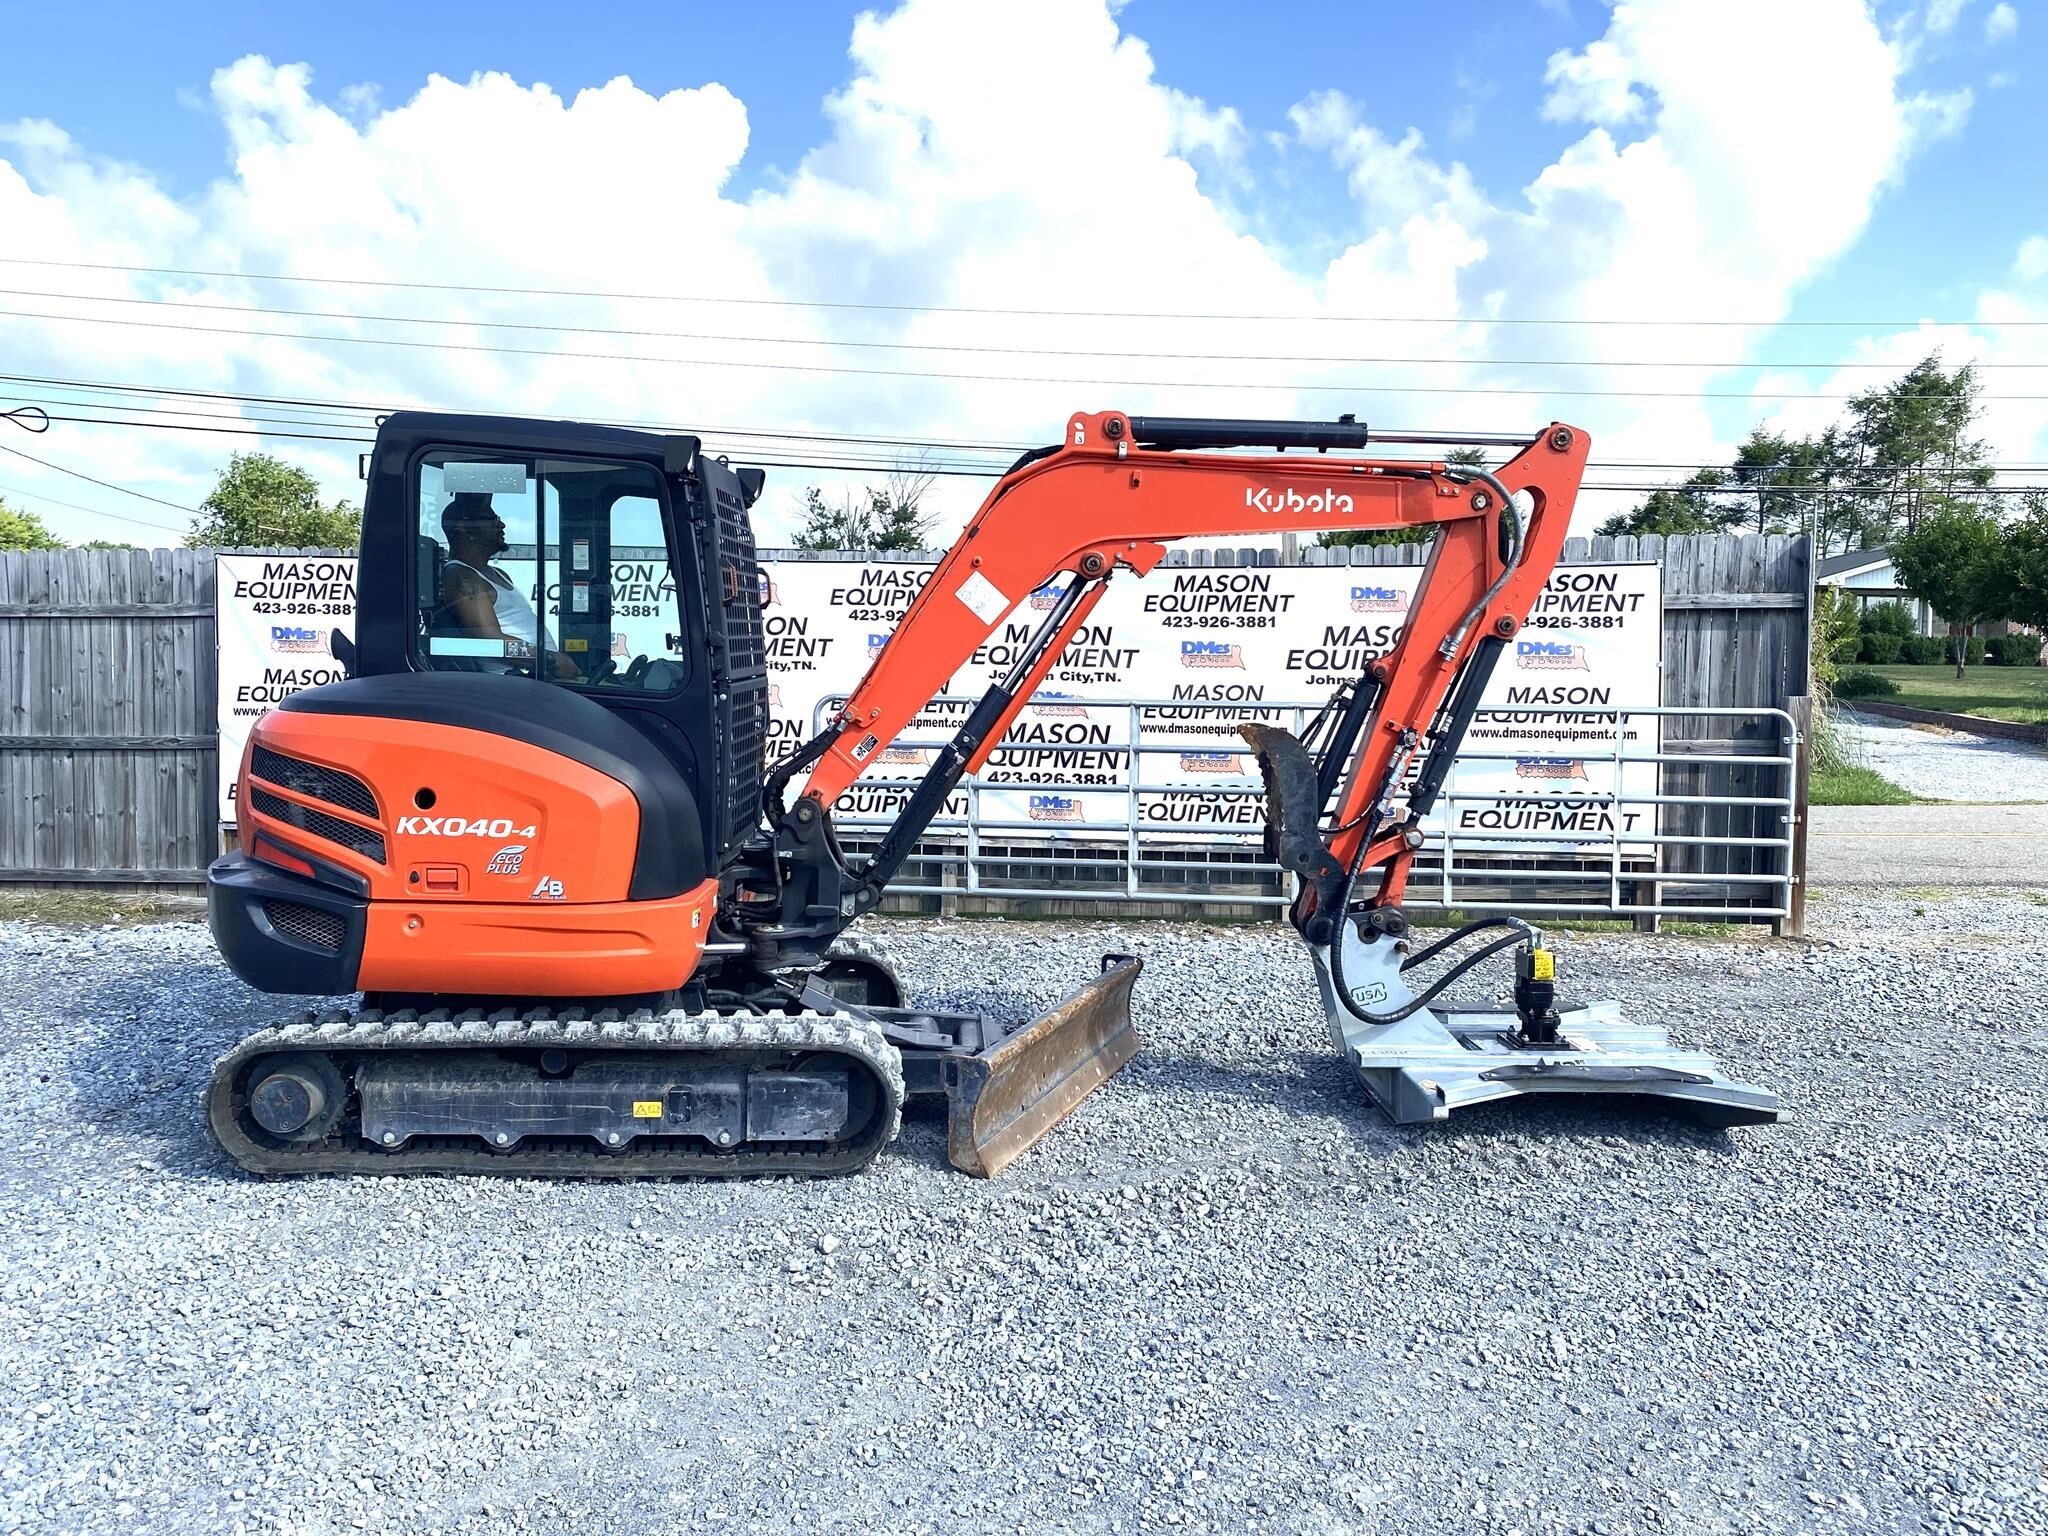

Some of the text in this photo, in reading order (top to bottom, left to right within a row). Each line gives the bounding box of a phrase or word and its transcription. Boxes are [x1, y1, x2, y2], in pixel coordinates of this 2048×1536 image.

[1246, 488, 1355, 513] Kubota
[262, 563, 354, 581] MASON
[234, 581, 357, 601] EQUIPMEN
[1174, 575, 1271, 593] MASON
[253, 602, 356, 616] 423-926-388
[1144, 595, 1295, 613] EQUIPMENT
[1534, 594, 1645, 613] IPMENT
[1162, 616, 1276, 628] 423-926-3881
[1005, 624, 1113, 645] MON
[1172, 685, 1264, 702] MASON
[1507, 687, 1611, 705] MASON
[1001, 723, 1112, 744] MASON
[988, 771, 1117, 785] 423-926-3881
[396, 816, 537, 838] KX040-4
[1460, 810, 1641, 832] EQUIPMENT
[496, 854, 524, 864] eco
[486, 863, 521, 875] PLUS
[532, 875, 565, 896] AB
[1356, 987, 1383, 1001] USA
